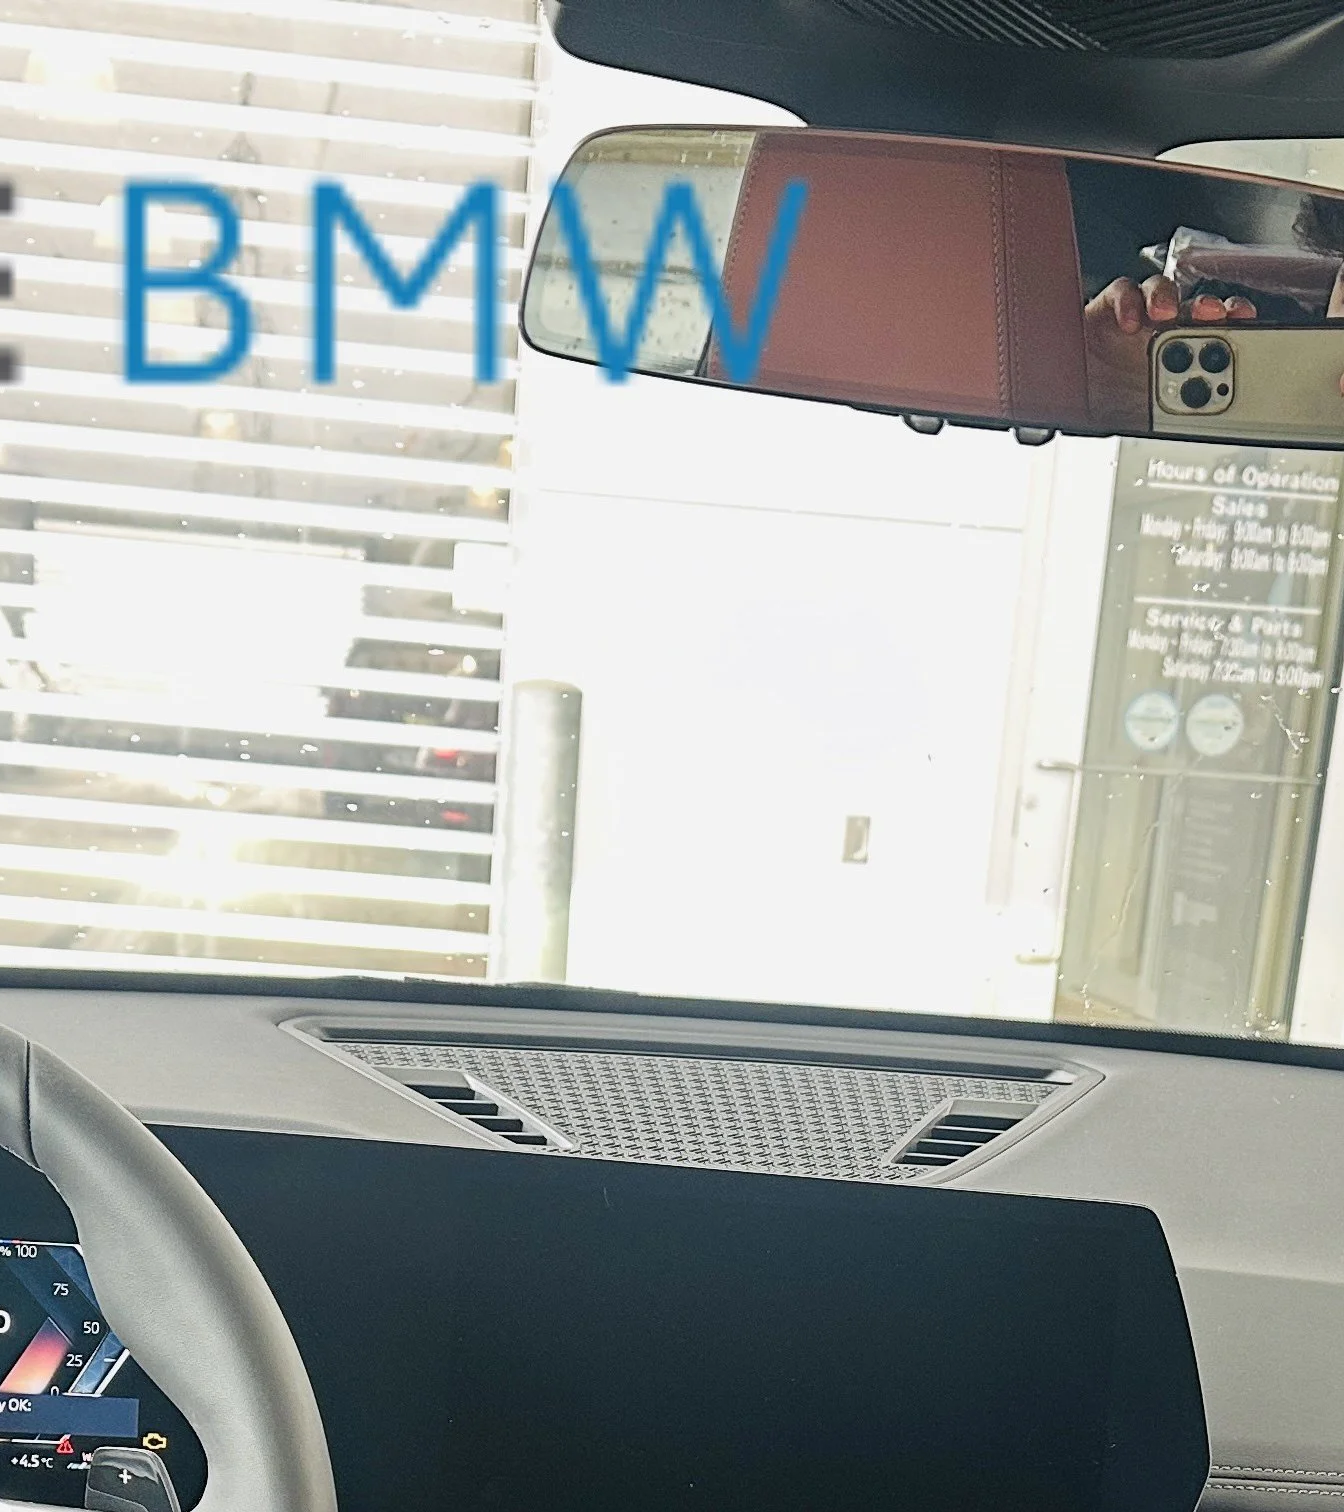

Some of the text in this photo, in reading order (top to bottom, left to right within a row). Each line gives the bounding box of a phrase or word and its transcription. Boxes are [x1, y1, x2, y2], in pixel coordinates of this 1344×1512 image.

[1148, 456, 1339, 491] Hours of Operation
[1211, 495, 1268, 519] Sales
[0, 1246, 11, 1257] %
[15, 1245, 37, 1258] 100
[53, 1283, 69, 1296] 75
[83, 1321, 100, 1334] 50
[66, 1354, 83, 1367] 25
[8, 1398, 32, 1412] OK:
